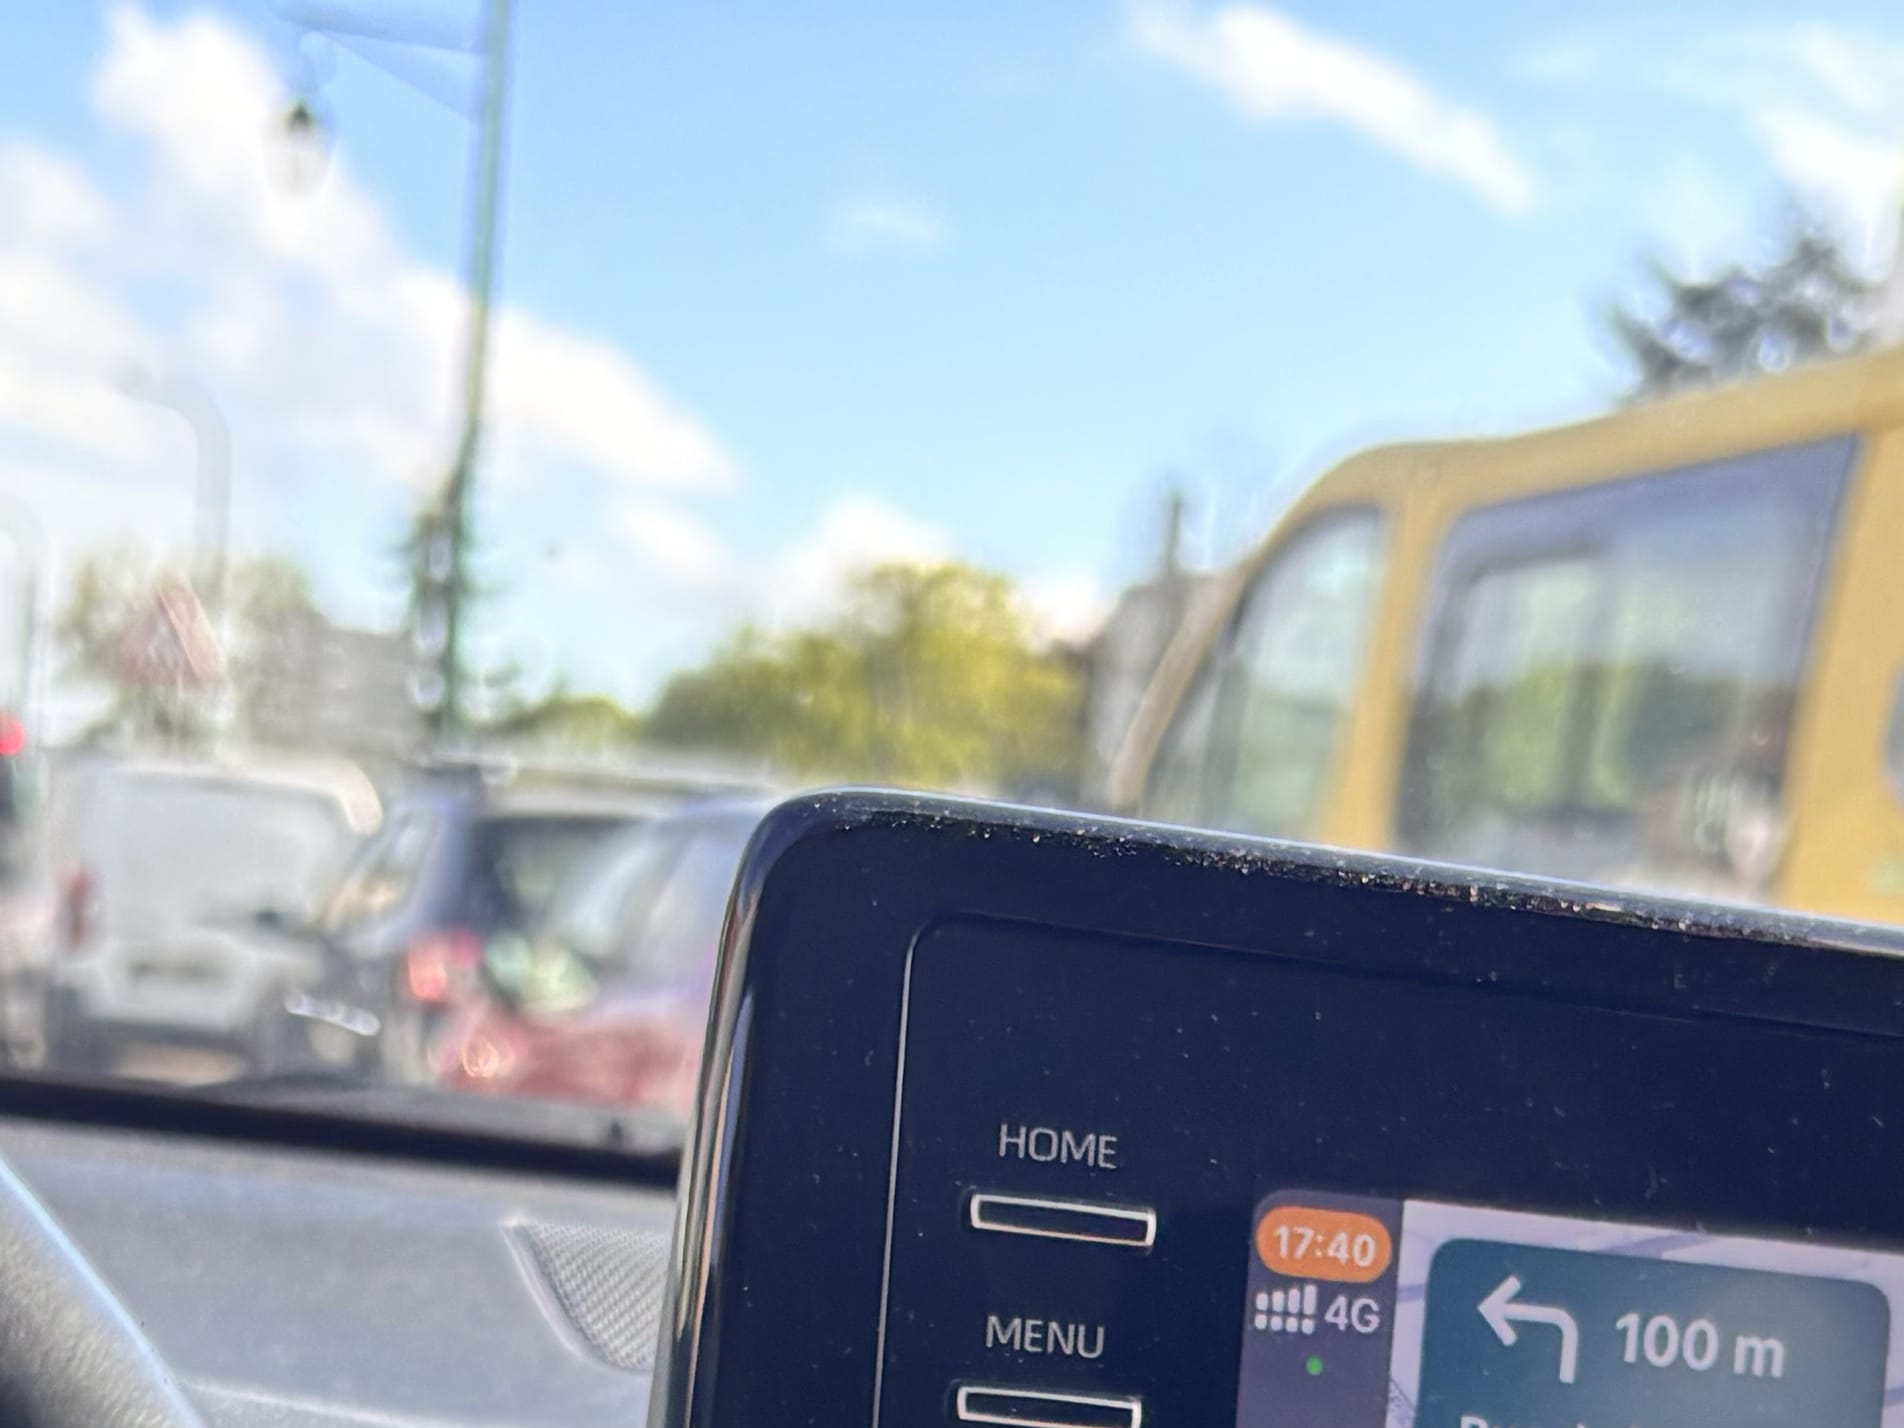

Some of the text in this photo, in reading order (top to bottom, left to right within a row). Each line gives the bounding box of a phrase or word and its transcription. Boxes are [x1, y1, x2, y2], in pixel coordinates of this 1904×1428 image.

[998, 1123, 1117, 1169] HOME
[1273, 1225, 1377, 1269] 17:40
[985, 1315, 1105, 1359] MENU
[1324, 1296, 1380, 1334] 4G
[1615, 1313, 1786, 1379] 100 m
